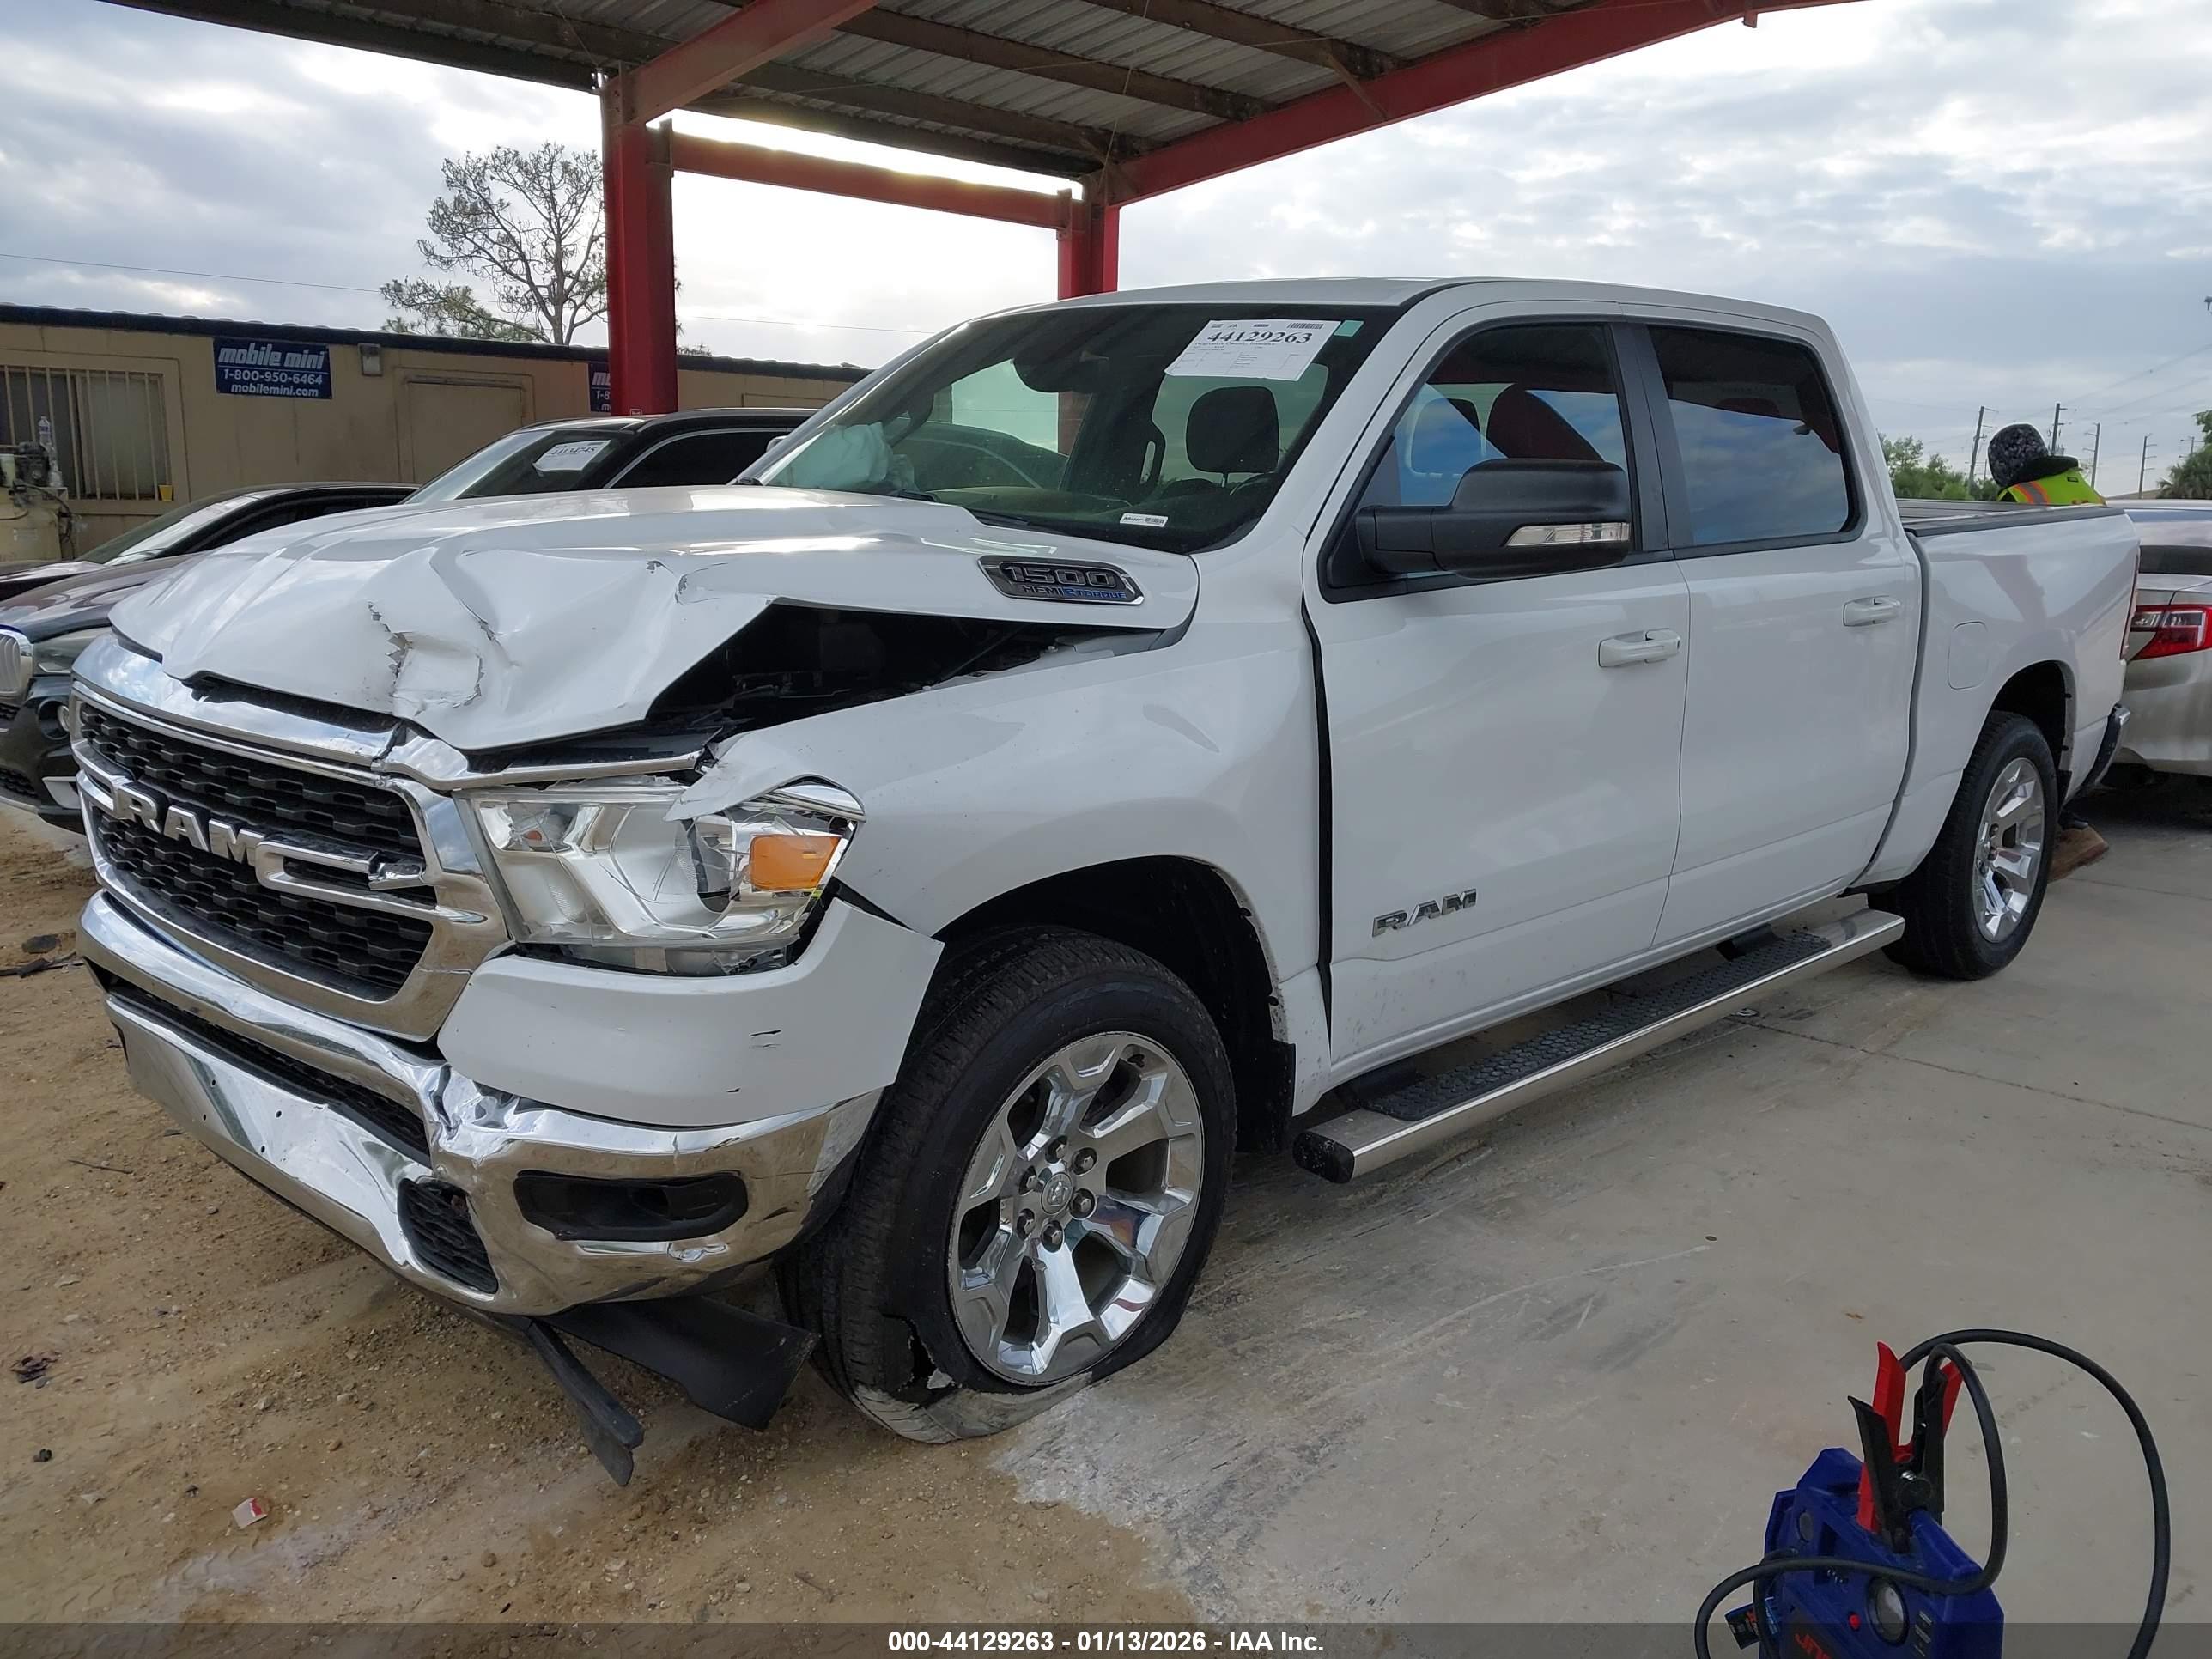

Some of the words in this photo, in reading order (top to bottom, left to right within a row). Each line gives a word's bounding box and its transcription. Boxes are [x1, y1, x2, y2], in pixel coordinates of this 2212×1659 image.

[1207, 331, 1312, 343] 44129263
[218, 343, 282, 367] mobile
[283, 349, 326, 370] mini
[224, 368, 323, 385] 1-800-950-6464
[231, 383, 319, 397] mobilemini.com
[1003, 566, 1116, 588] 1500
[116, 779, 264, 866] RAM
[1372, 888, 1477, 938] RAM
